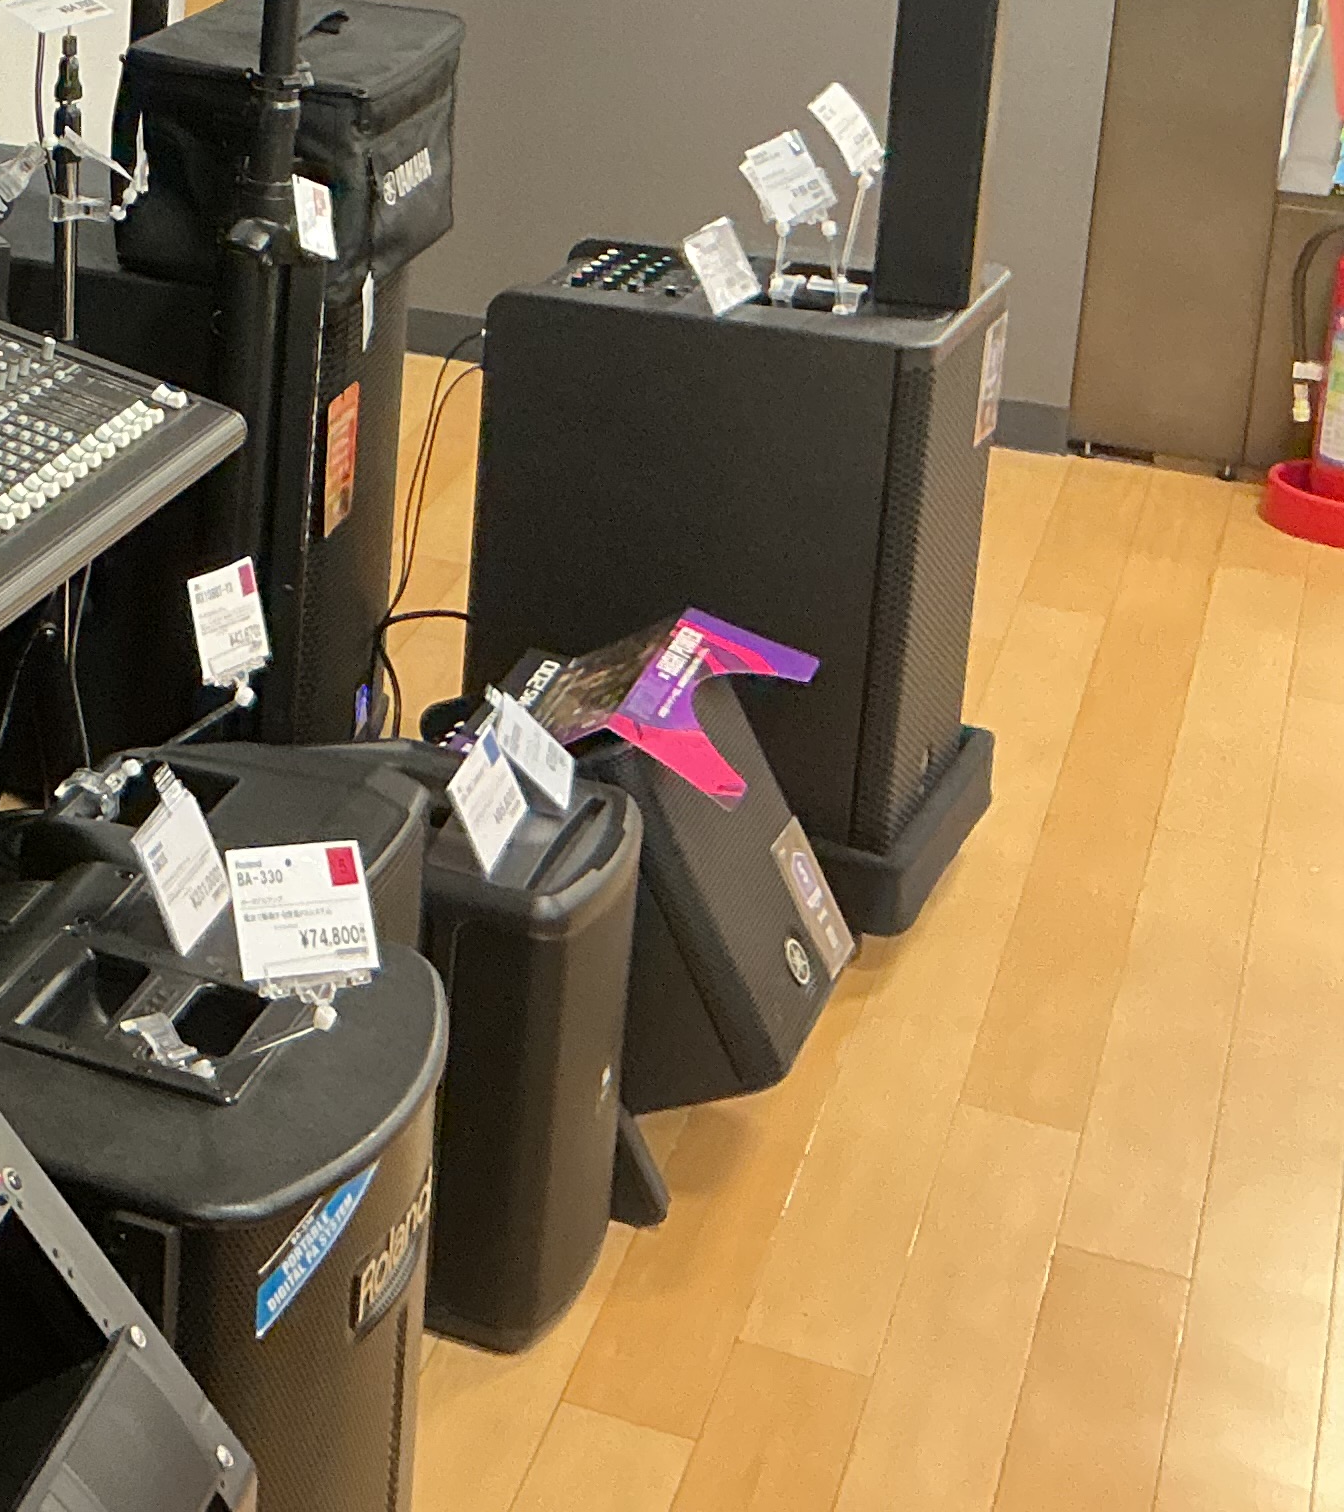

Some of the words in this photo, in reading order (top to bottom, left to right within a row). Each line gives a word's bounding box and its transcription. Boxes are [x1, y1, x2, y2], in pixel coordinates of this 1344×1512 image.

[236, 869, 284, 887] BA-330
[299, 924, 360, 949] ¥74,800
[267, 1263, 307, 1313] DIGITAL
[318, 1191, 355, 1256] SYSTEM
[281, 1209, 330, 1276] PORTABLE
[358, 1164, 434, 1324] Roland
